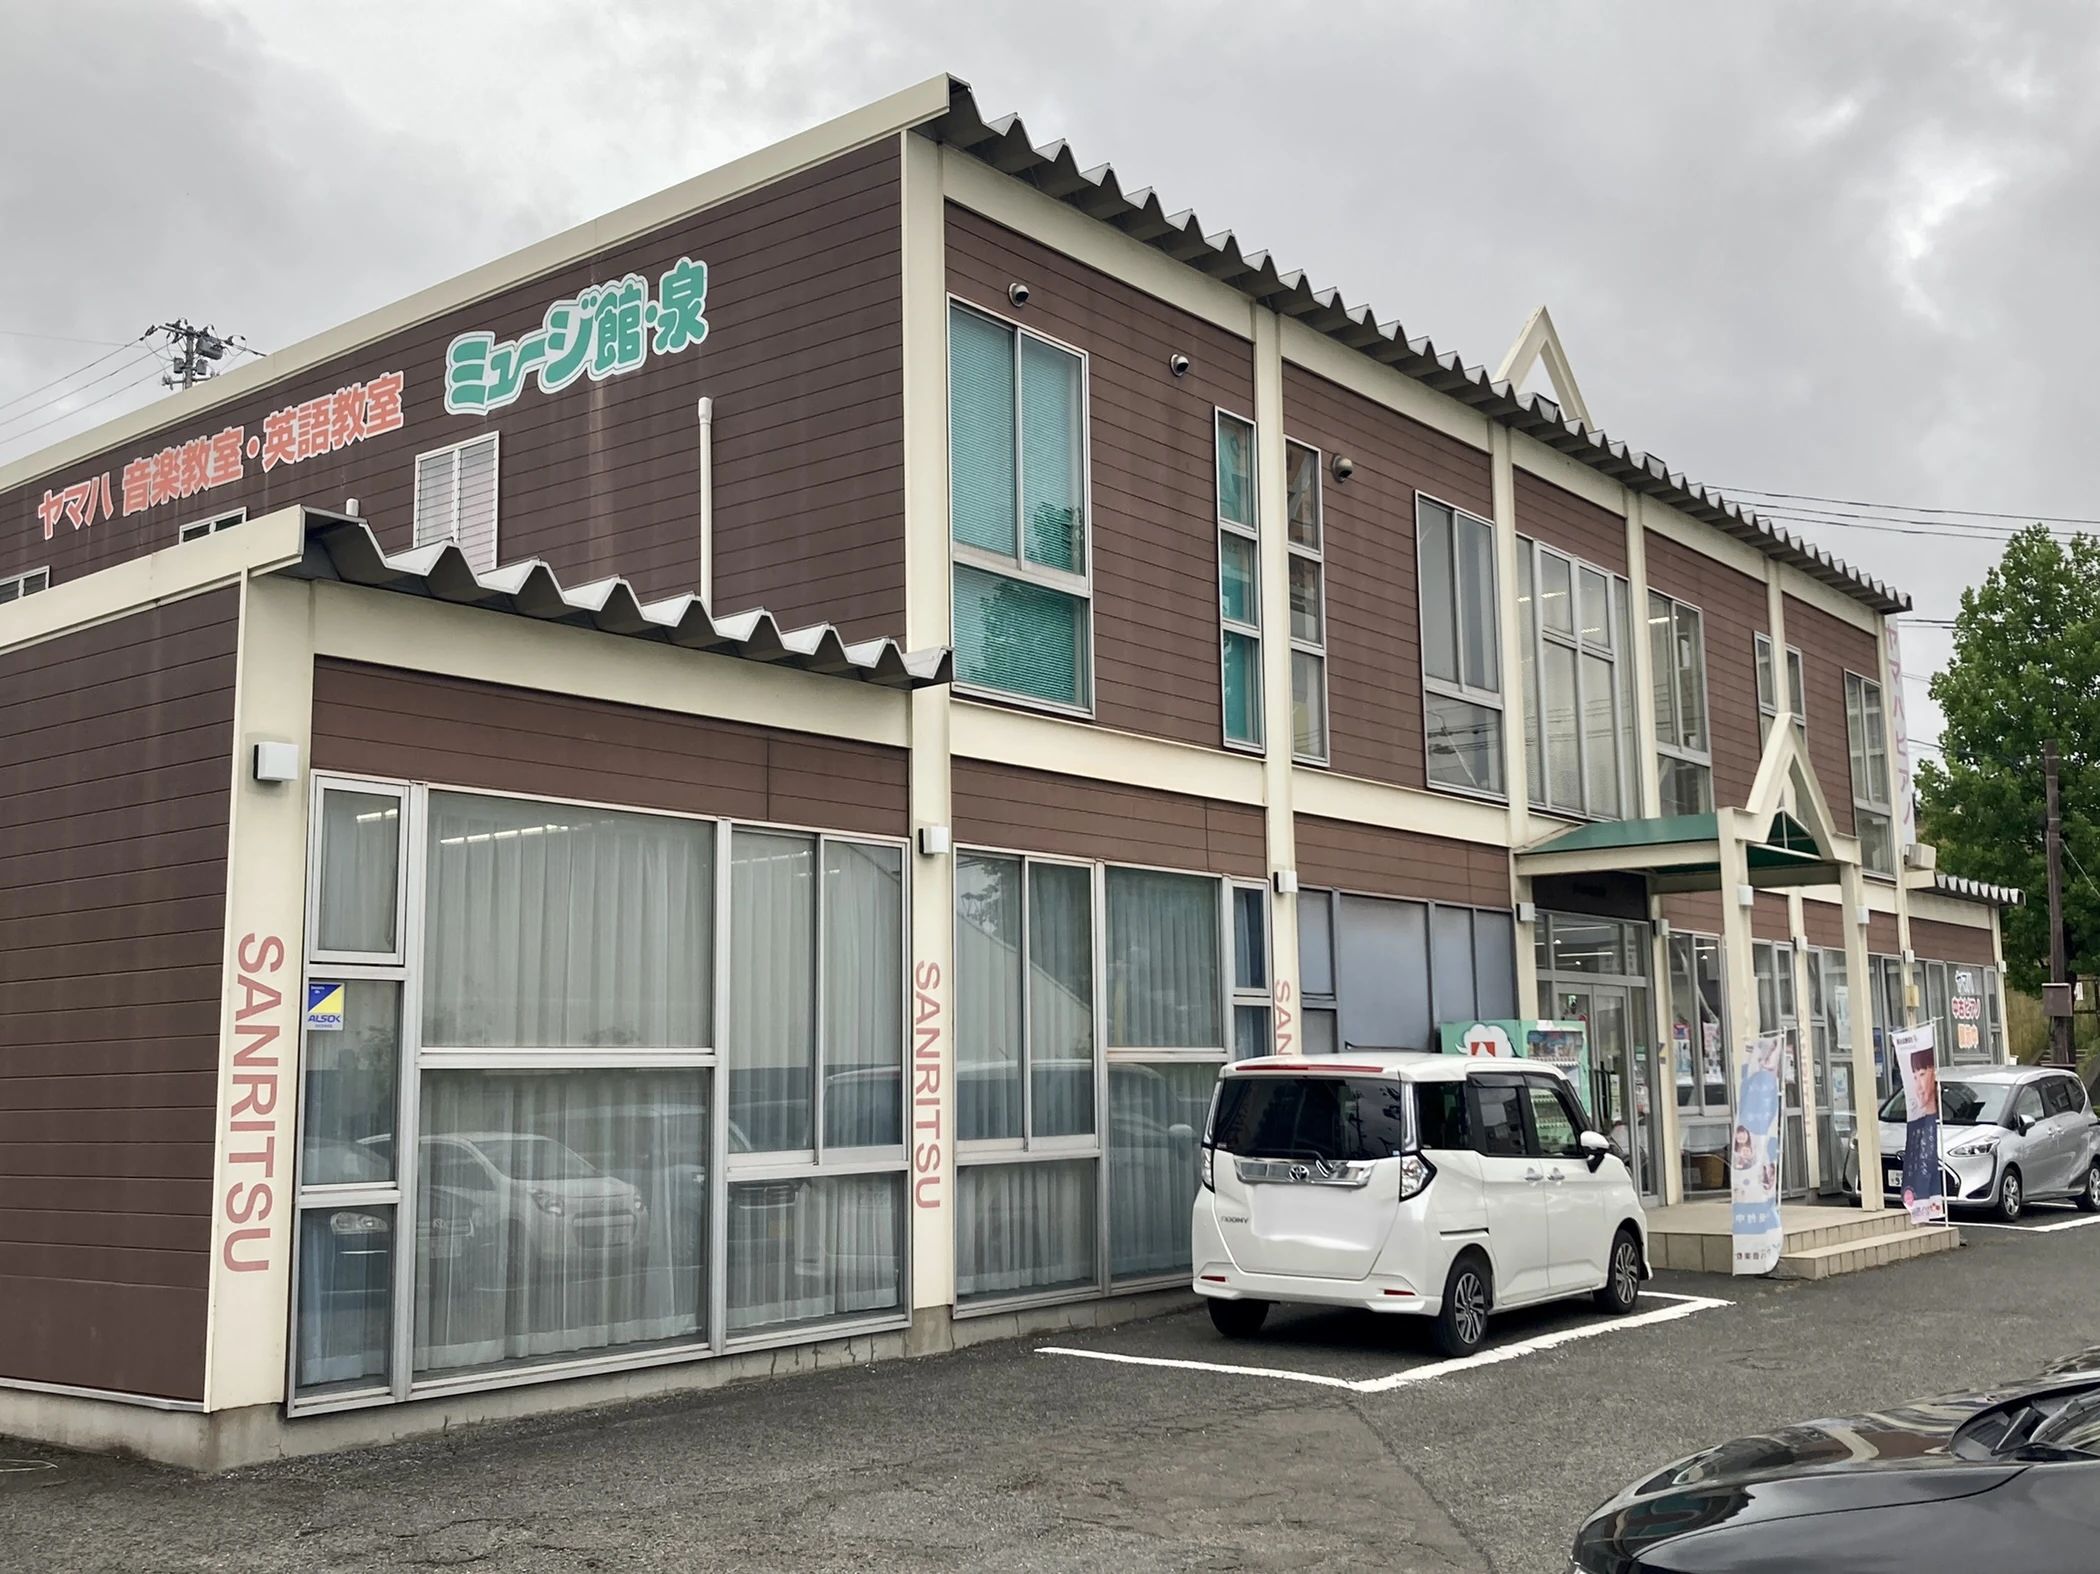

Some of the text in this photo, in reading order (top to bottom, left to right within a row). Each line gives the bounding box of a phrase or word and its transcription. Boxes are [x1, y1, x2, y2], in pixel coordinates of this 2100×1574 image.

[38, 370, 404, 540] ヤマハ 音楽教室・英語教室
[223, 933, 285, 1272] SANRITSU
[308, 1014, 341, 1023] ALSOK
[915, 960, 941, 1209] SANRITSU
